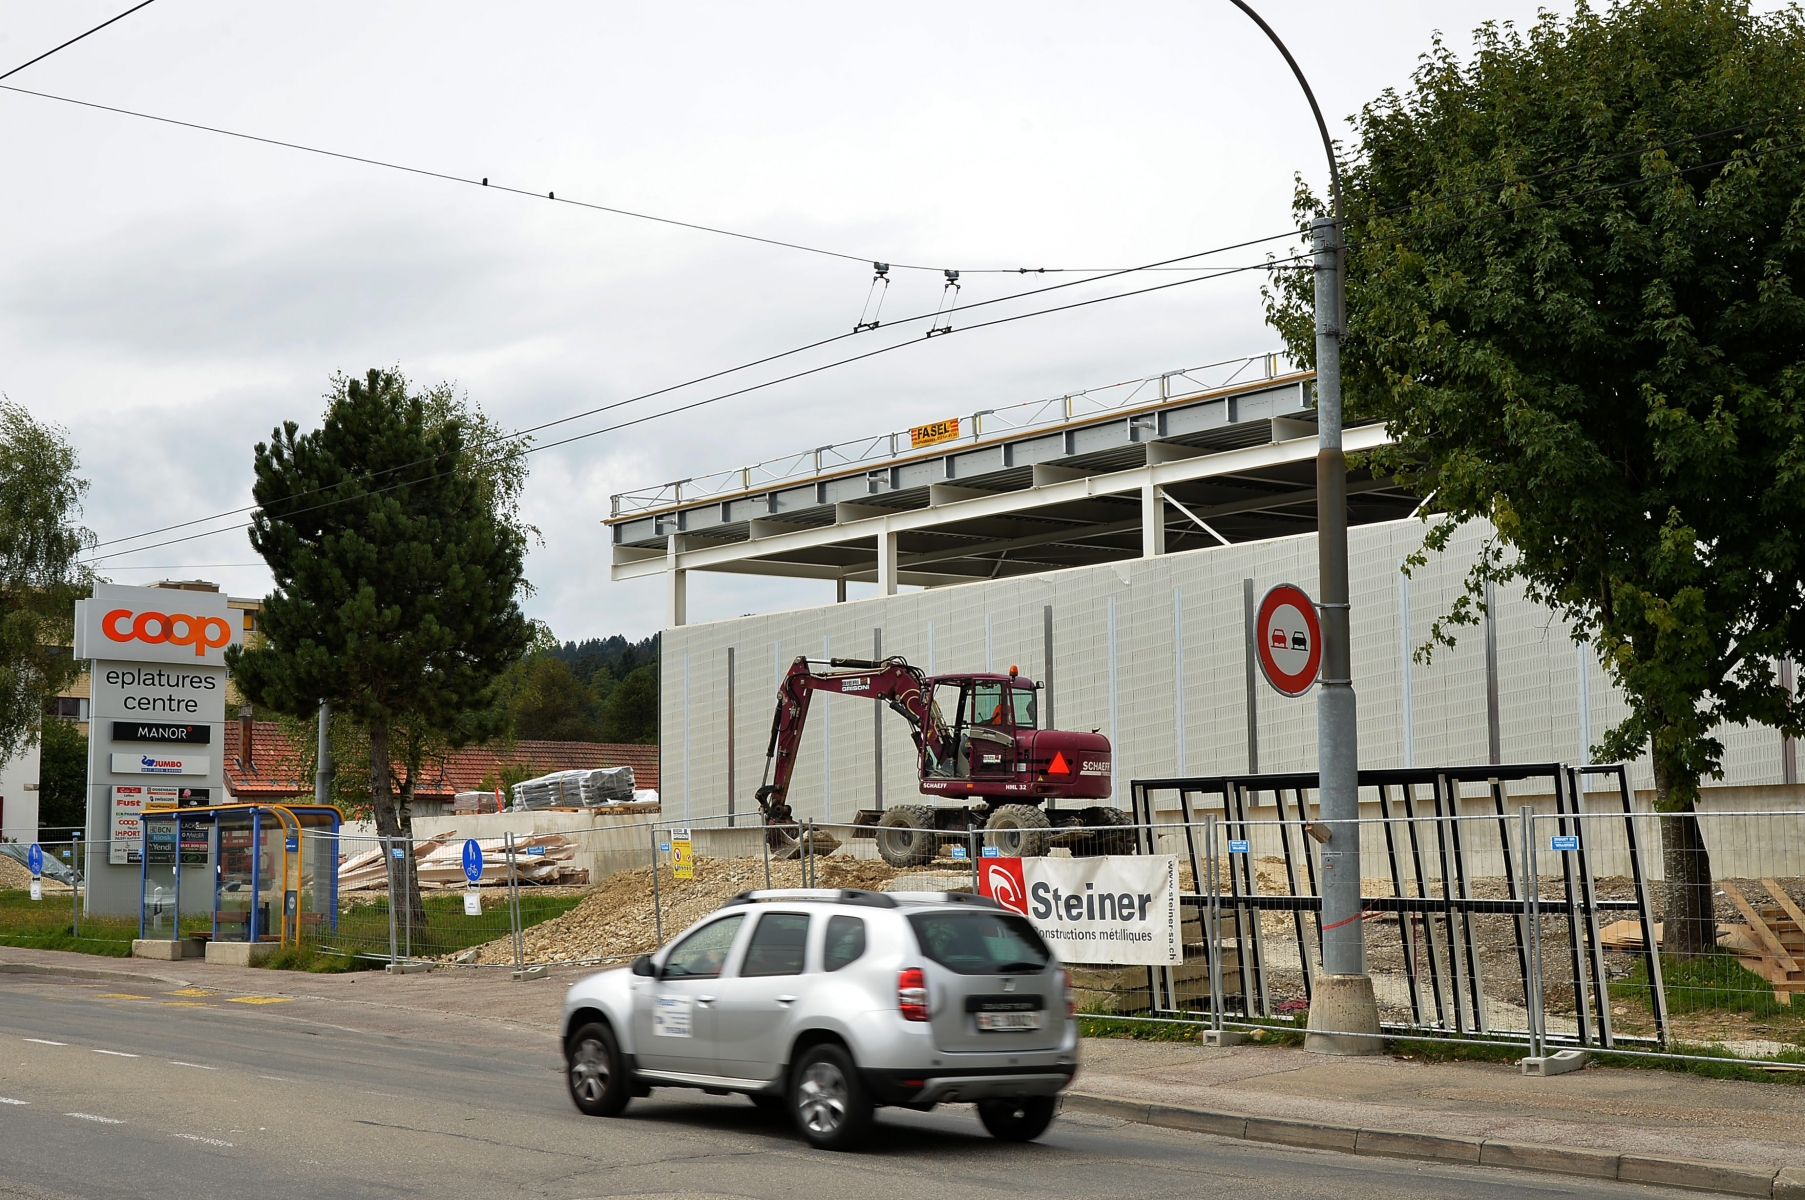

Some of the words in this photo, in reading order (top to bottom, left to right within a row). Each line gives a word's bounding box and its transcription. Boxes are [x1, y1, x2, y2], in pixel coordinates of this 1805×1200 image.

[917, 422, 949, 440] FASEL
[102, 608, 231, 656] coop
[105, 667, 216, 690] eplatures
[123, 693, 198, 713] centre
[137, 726, 187, 739] MANOR
[153, 760, 182, 768] JUMBO
[1082, 760, 1111, 771] SCHAEFF
[152, 843, 172, 851] Yendi
[1031, 881, 1152, 922] Steiner
[1166, 860, 1177, 961] www.steiner-sa.ch
